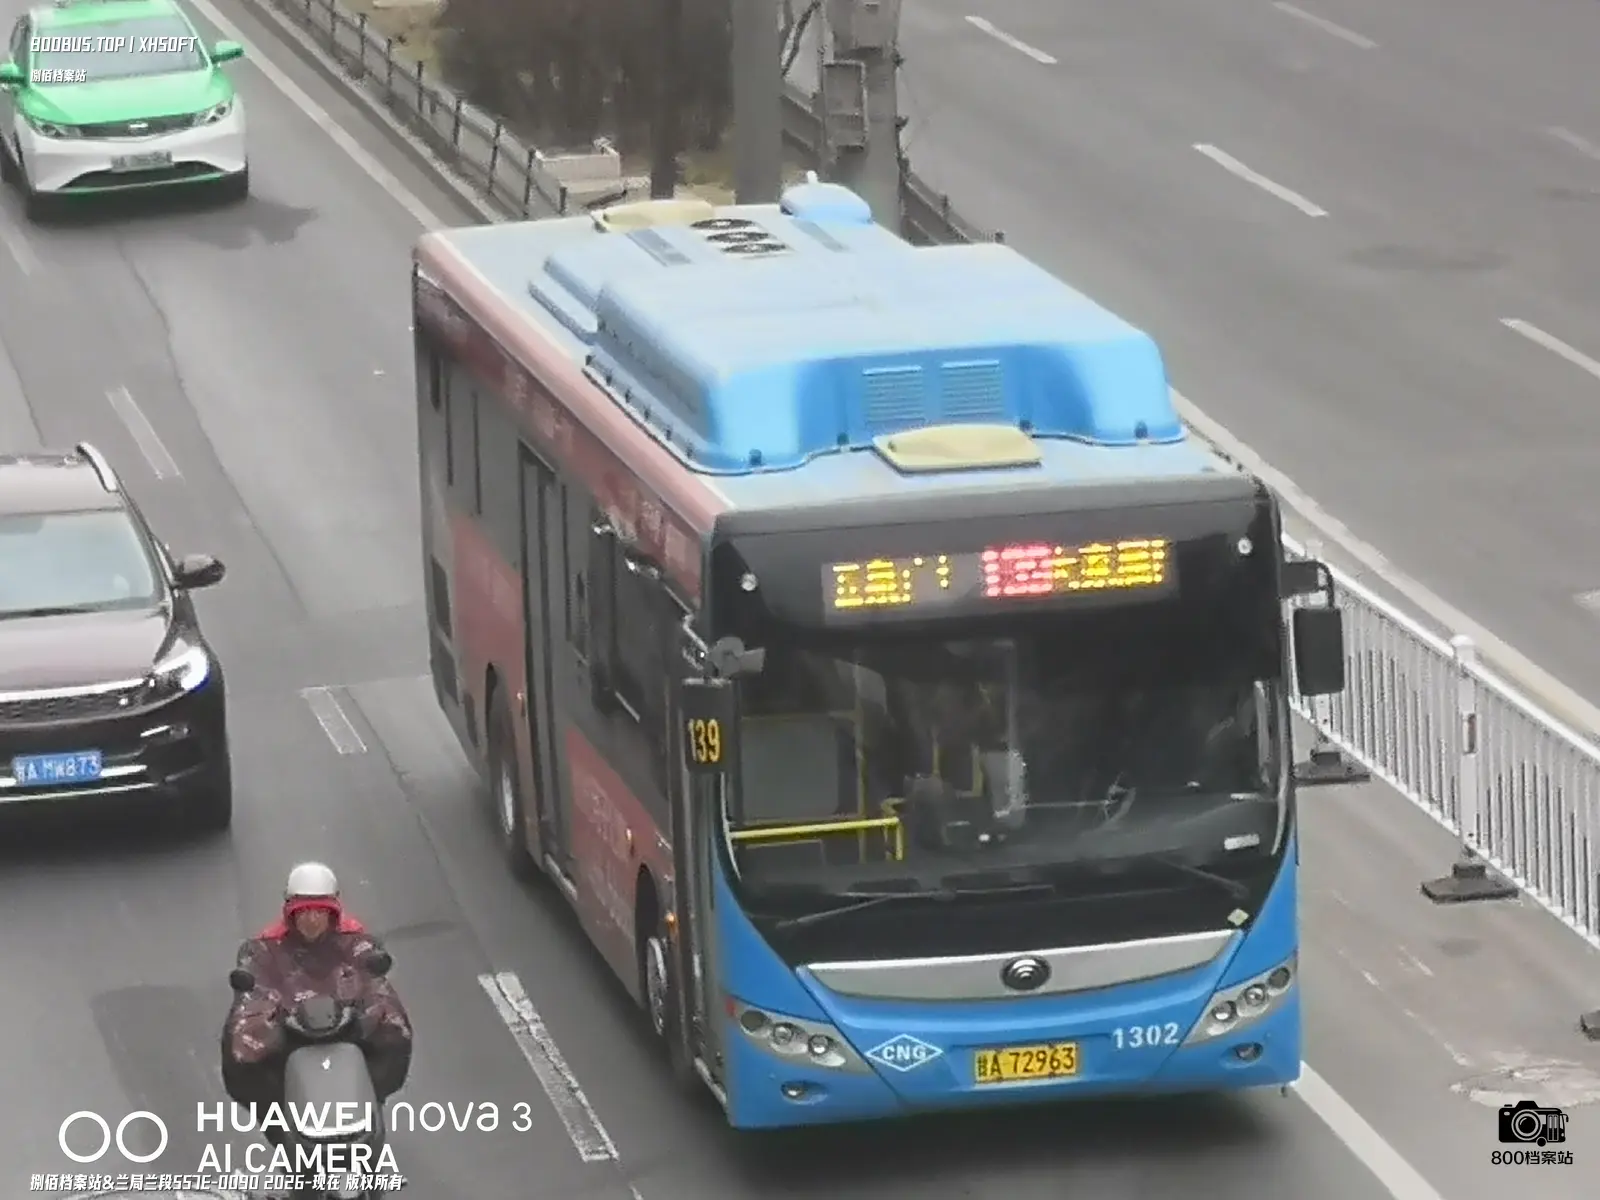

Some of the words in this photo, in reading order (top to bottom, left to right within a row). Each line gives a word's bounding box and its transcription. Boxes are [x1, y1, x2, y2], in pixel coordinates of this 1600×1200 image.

[687, 718, 720, 761] 139
[1111, 1022, 1179, 1049] 1302
[881, 1045, 928, 1061] CNG
